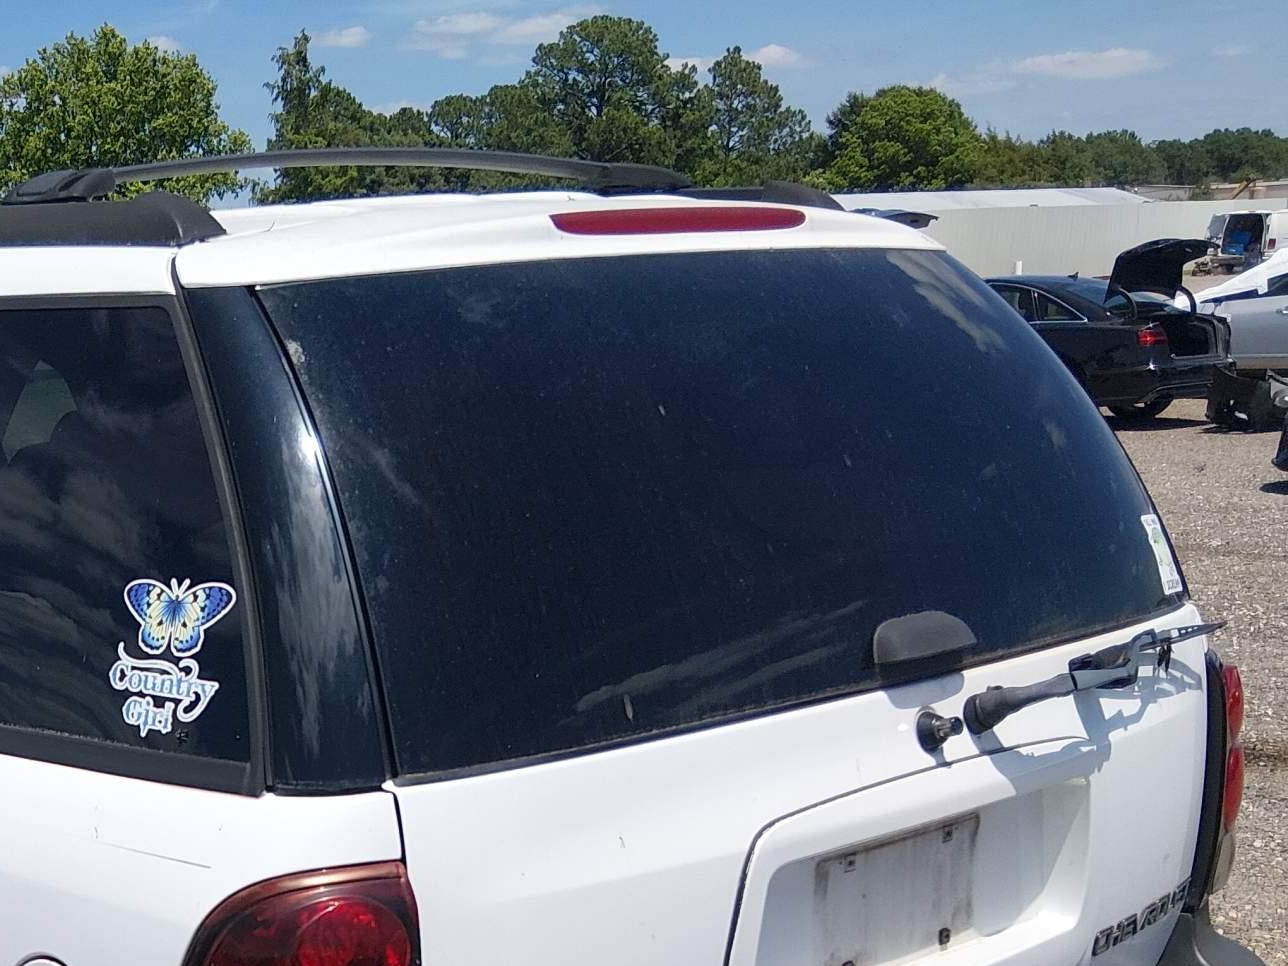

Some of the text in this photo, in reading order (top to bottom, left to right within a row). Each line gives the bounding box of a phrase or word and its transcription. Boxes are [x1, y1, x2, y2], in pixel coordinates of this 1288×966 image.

[109, 643, 220, 722] Country
[122, 696, 175, 737] Girl
[1093, 878, 1191, 956] CHEVROLET
